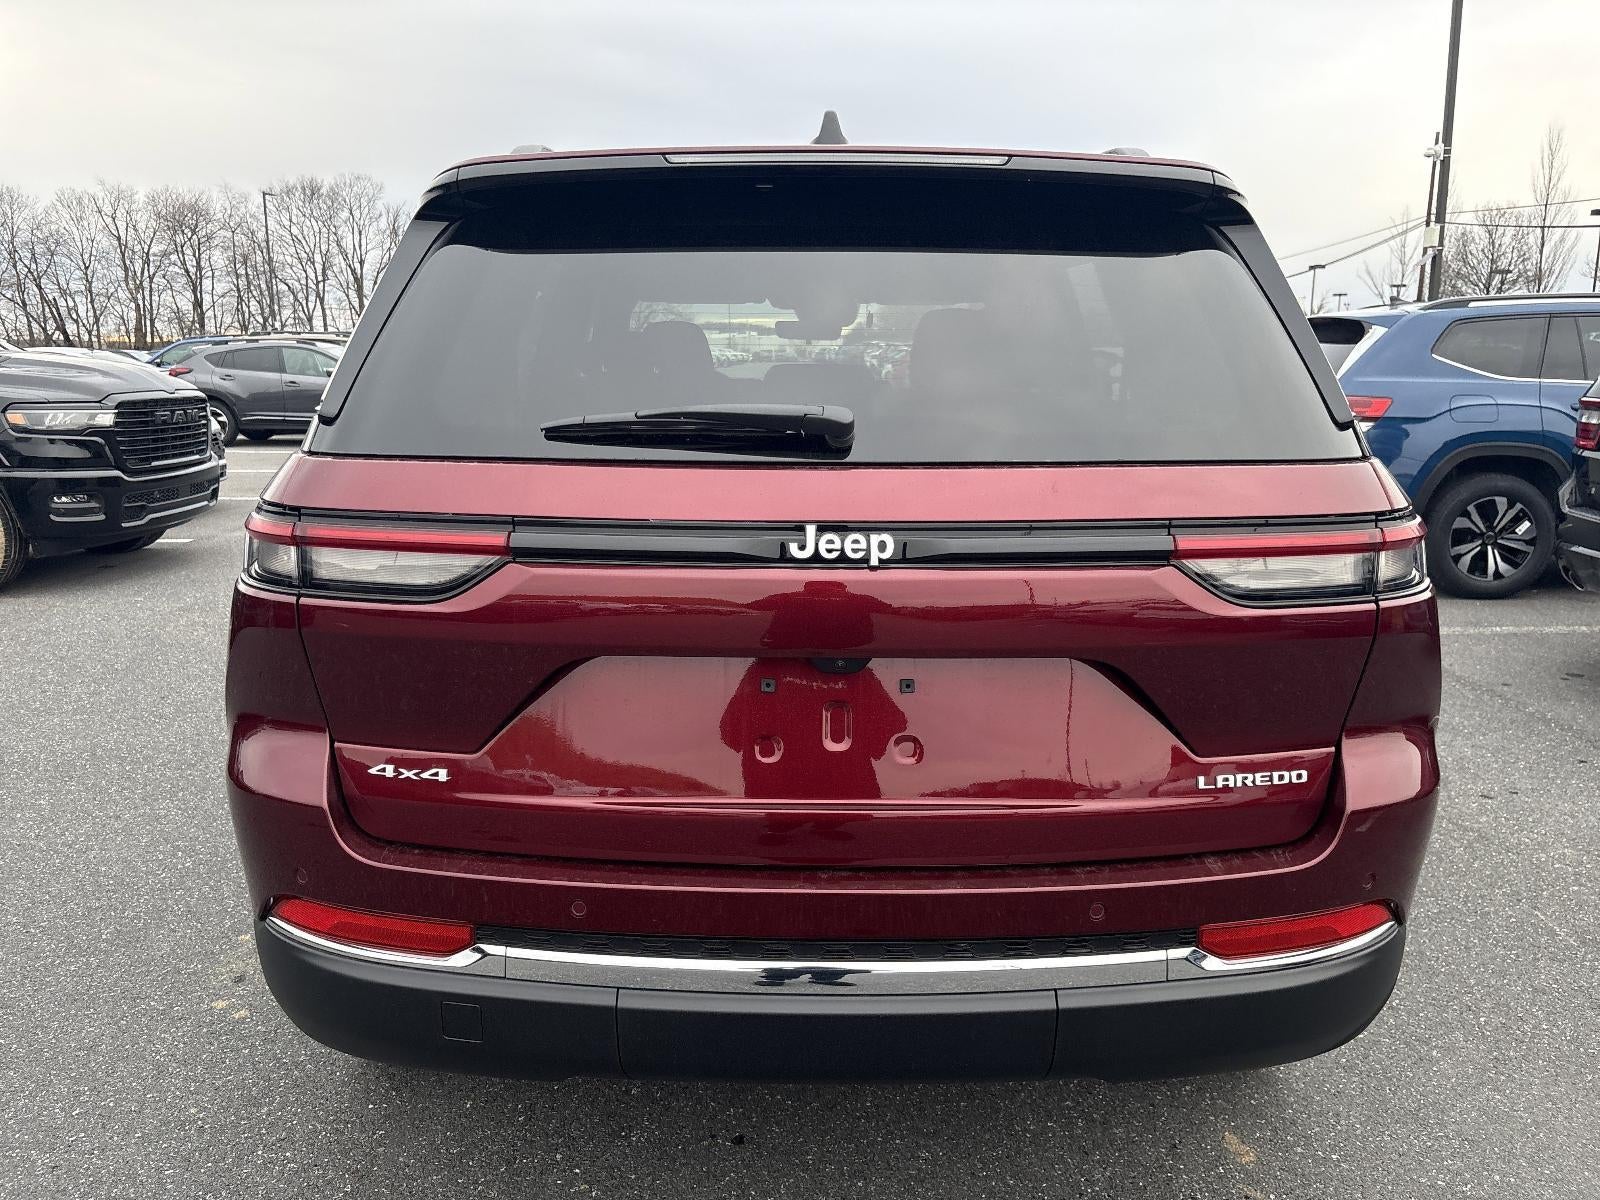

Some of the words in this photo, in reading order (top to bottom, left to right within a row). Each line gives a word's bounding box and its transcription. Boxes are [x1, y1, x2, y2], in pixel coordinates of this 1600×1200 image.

[789, 524, 895, 566] Jeep
[367, 764, 452, 781] 4x4
[1198, 769, 1308, 789] LAREDO
